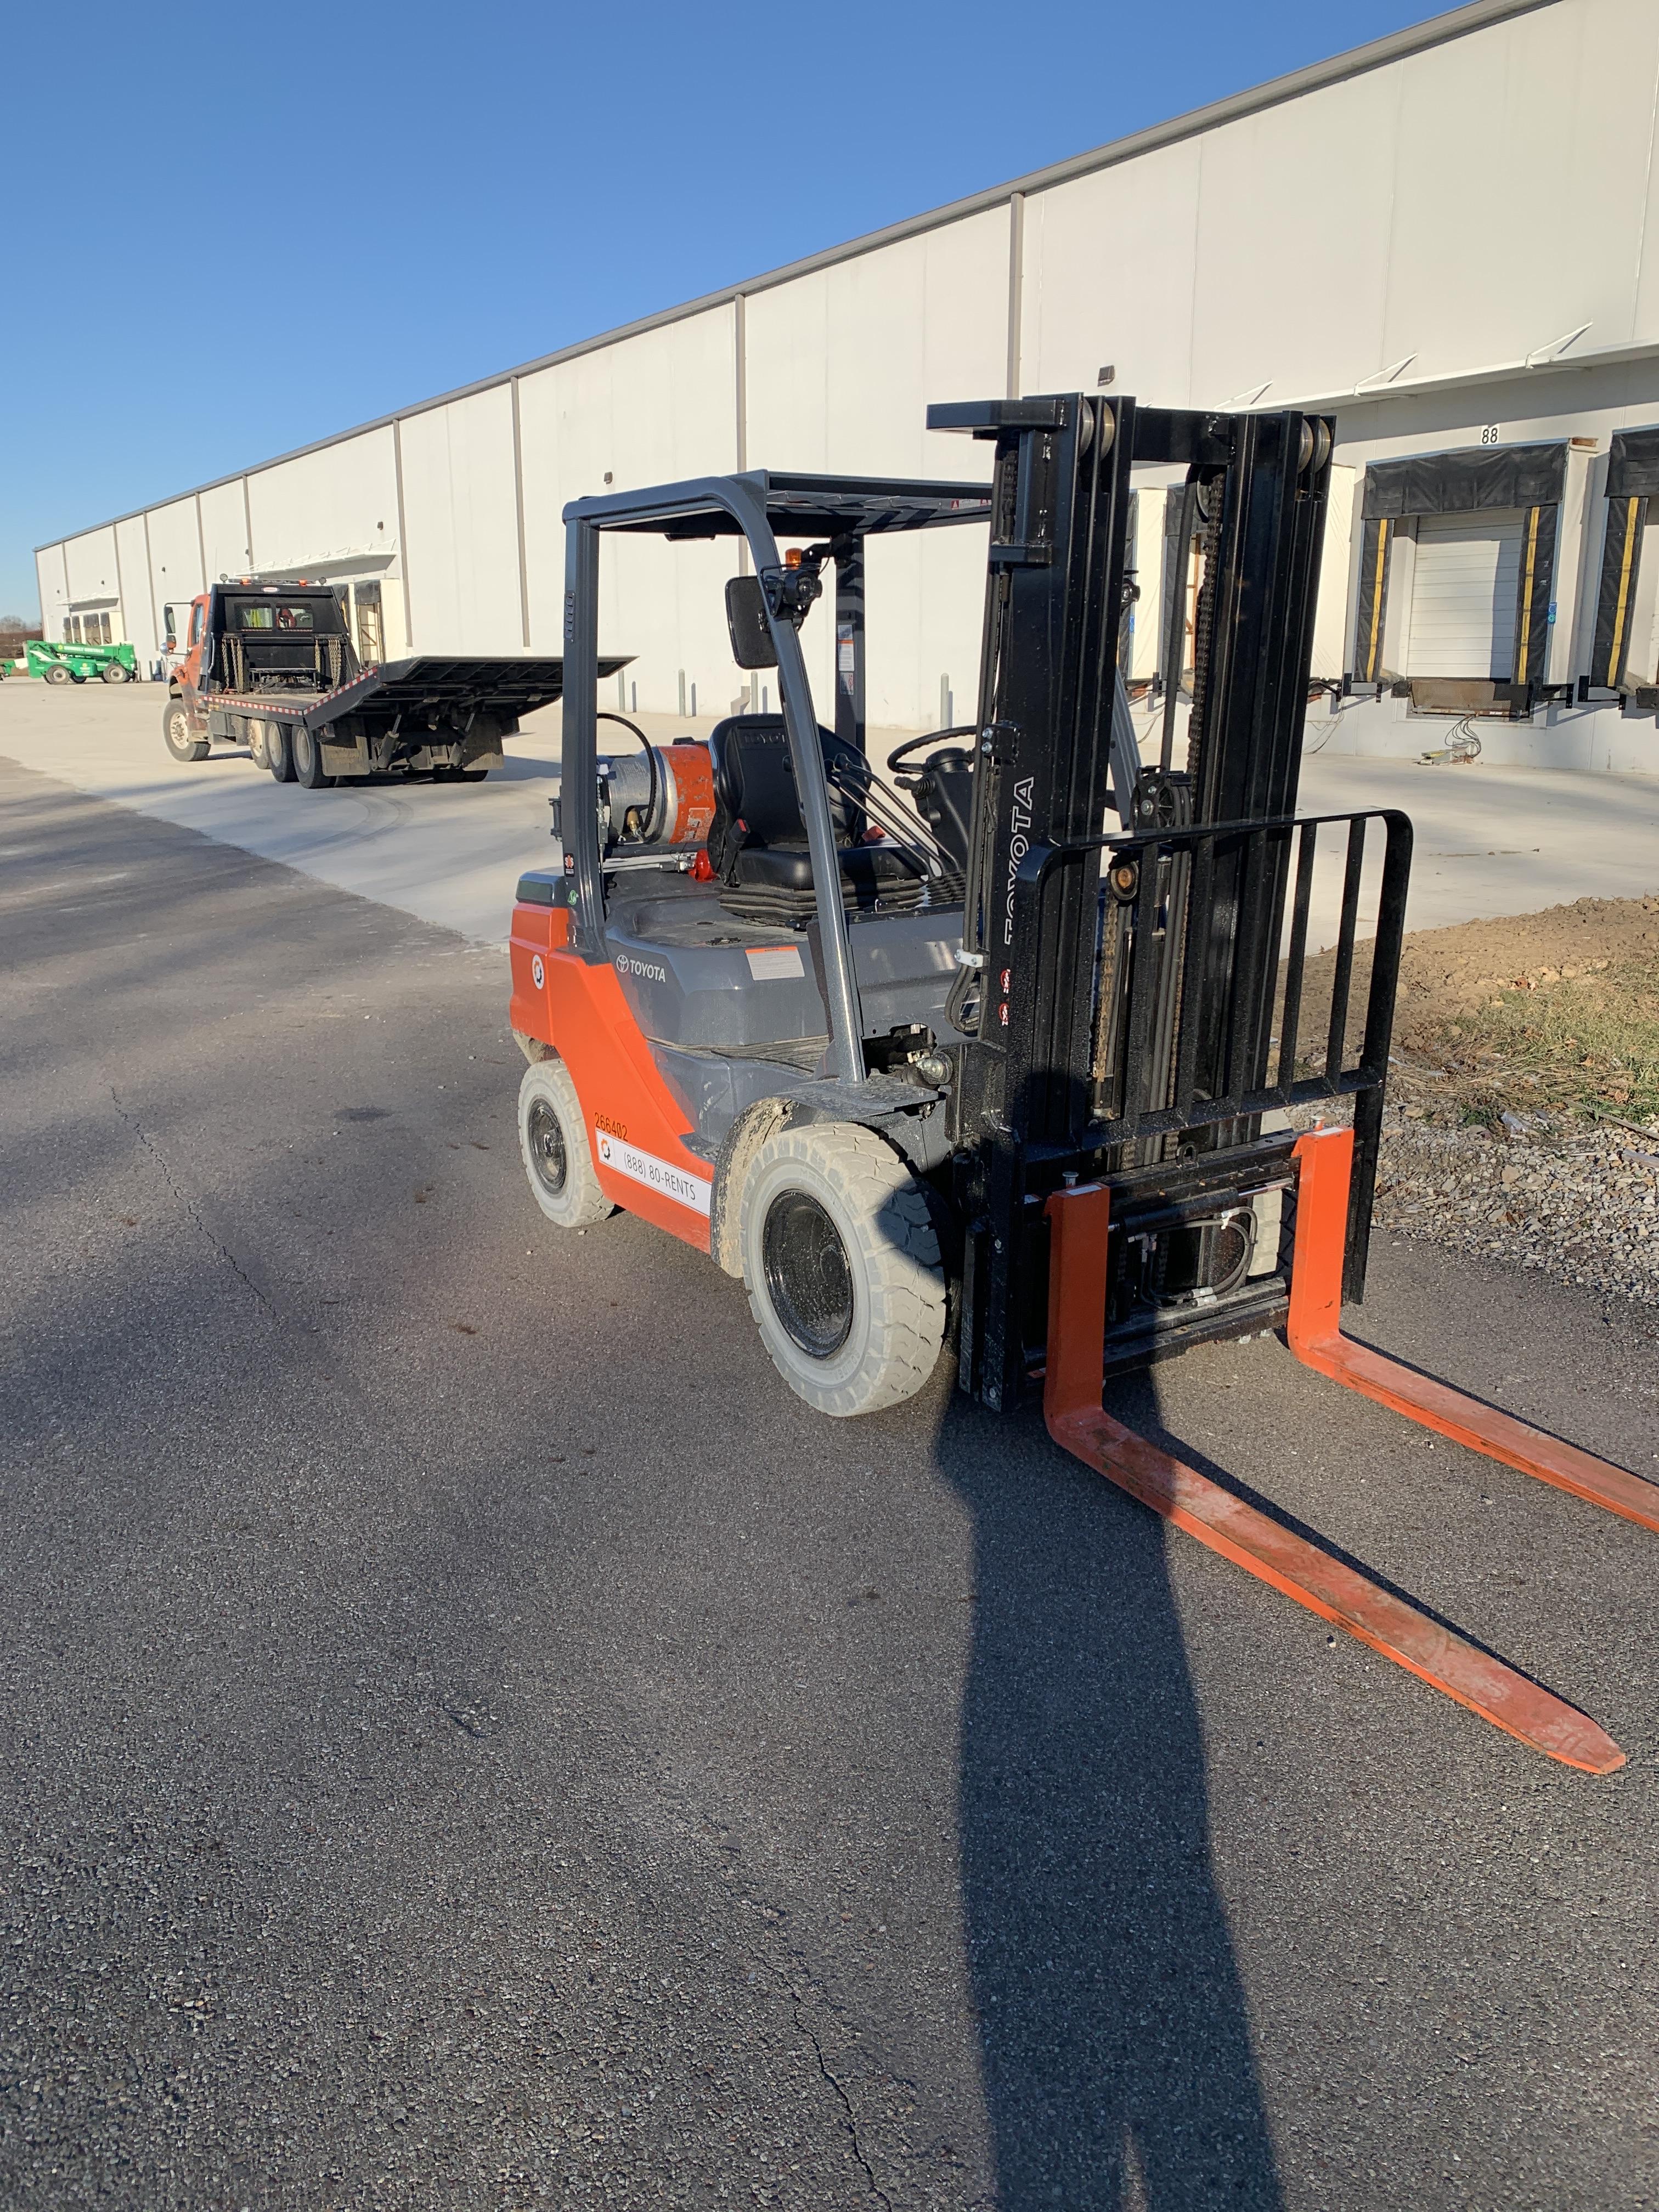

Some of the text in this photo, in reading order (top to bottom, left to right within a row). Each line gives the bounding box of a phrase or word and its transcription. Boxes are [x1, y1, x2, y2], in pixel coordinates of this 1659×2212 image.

[1482, 428, 1498, 444] 88
[630, 960, 666, 983] TOYOTA
[595, 1113, 628, 1142] 266402
[624, 1152, 696, 1200] (888) 80-RENTS
